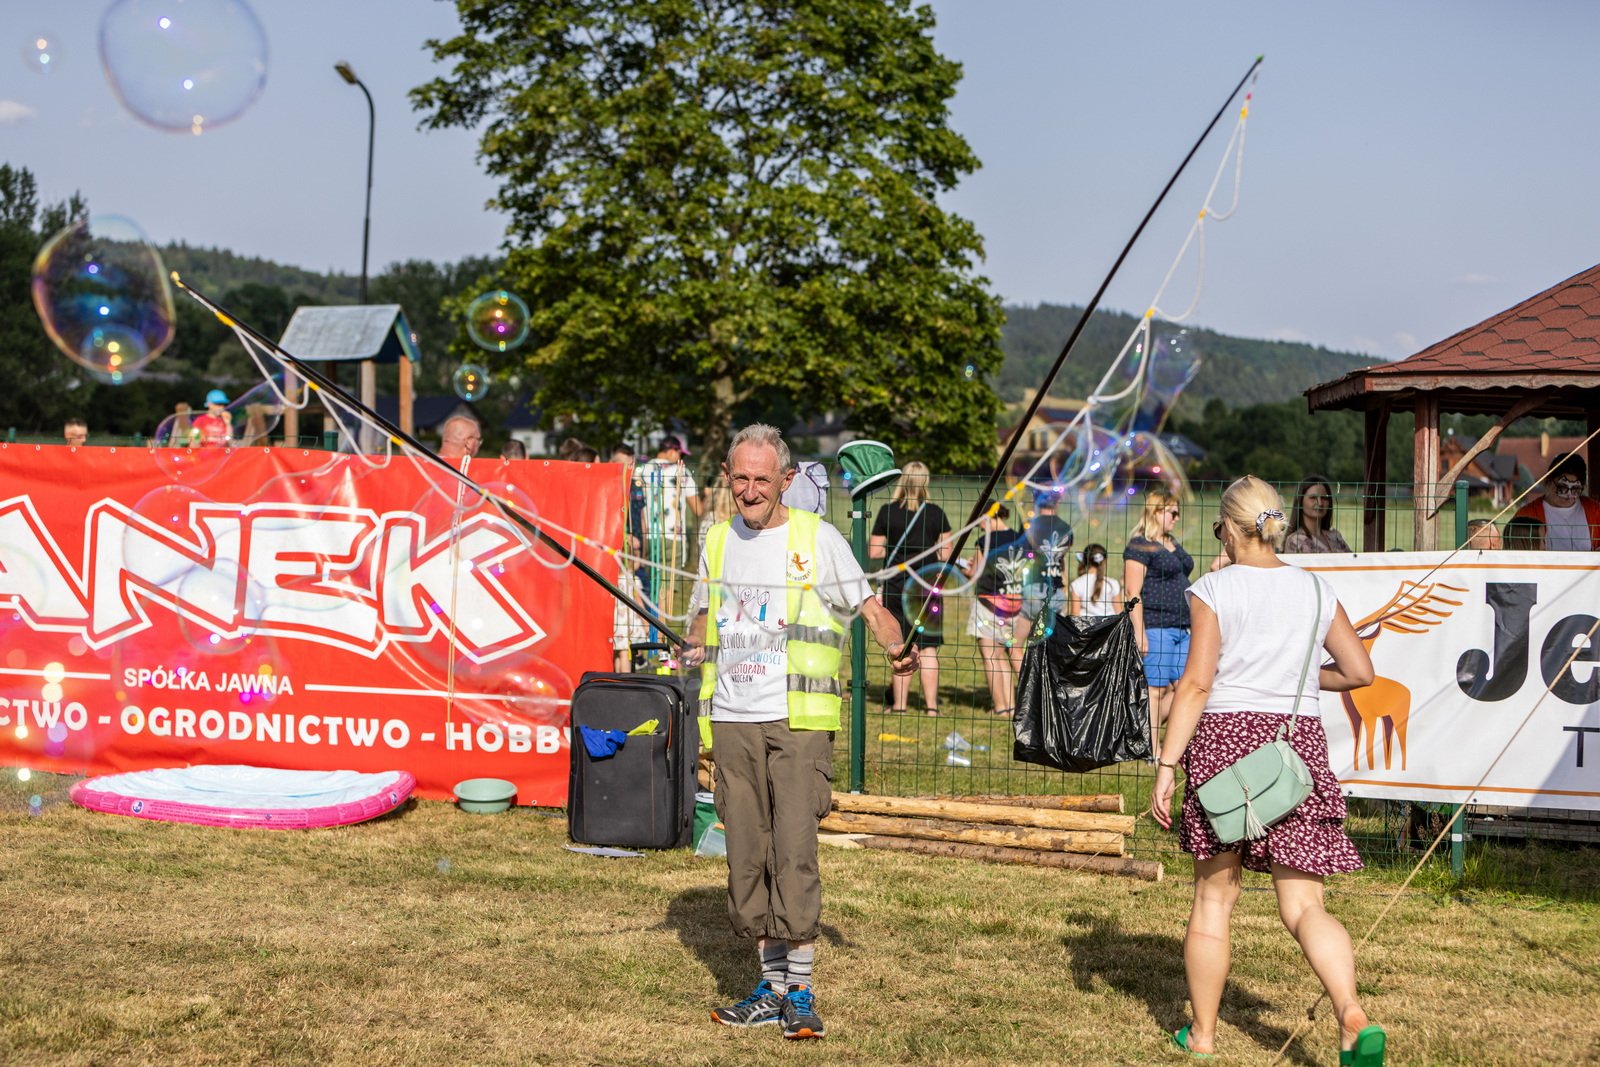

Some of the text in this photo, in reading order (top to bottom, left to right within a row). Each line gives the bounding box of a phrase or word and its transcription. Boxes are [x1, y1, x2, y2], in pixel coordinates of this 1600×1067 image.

[1456, 582, 1600, 705] Je
[124, 665, 294, 696] SPÓŁKA JAWNA
[120, 705, 411, 749] OGRODNICTWO
[445, 722, 571, 754] HOBB
